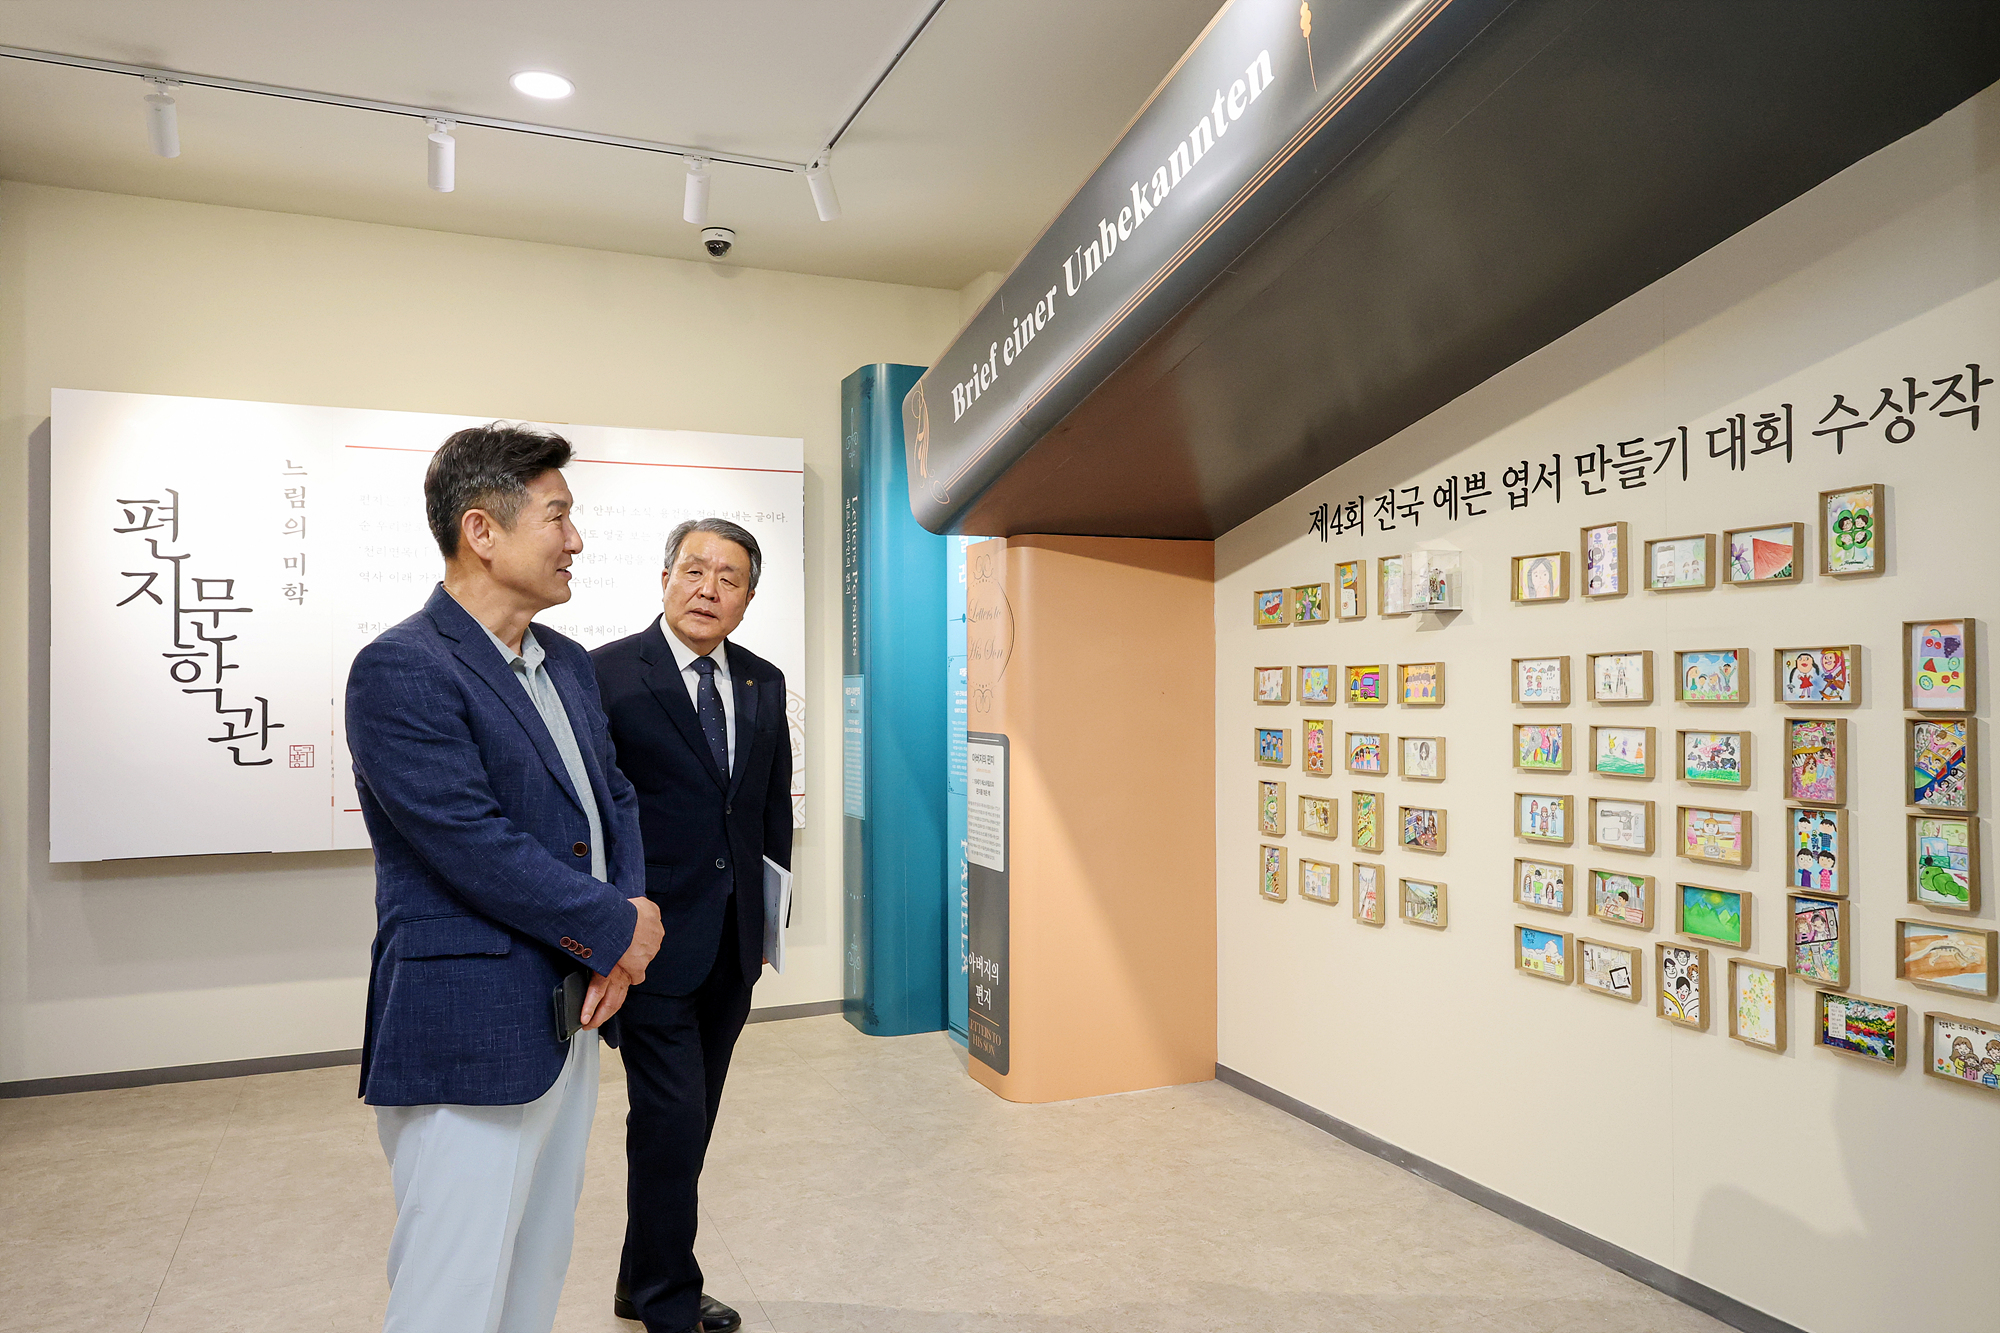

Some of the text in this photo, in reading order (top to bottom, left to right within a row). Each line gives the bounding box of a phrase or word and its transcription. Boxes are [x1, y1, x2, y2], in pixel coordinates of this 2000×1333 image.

[951, 48, 1276, 423] Brief einer Unbekannten
[1308, 364, 1994, 543] 제4회 전국 예쁜 엽서 만들기 대회 수상작
[593, 504, 627, 516] 안부나
[282, 459, 309, 606] 느림의 미학
[359, 570, 384, 583] 역사
[969, 951, 999, 985] 아버지의
[975, 984, 992, 1010] 편지
